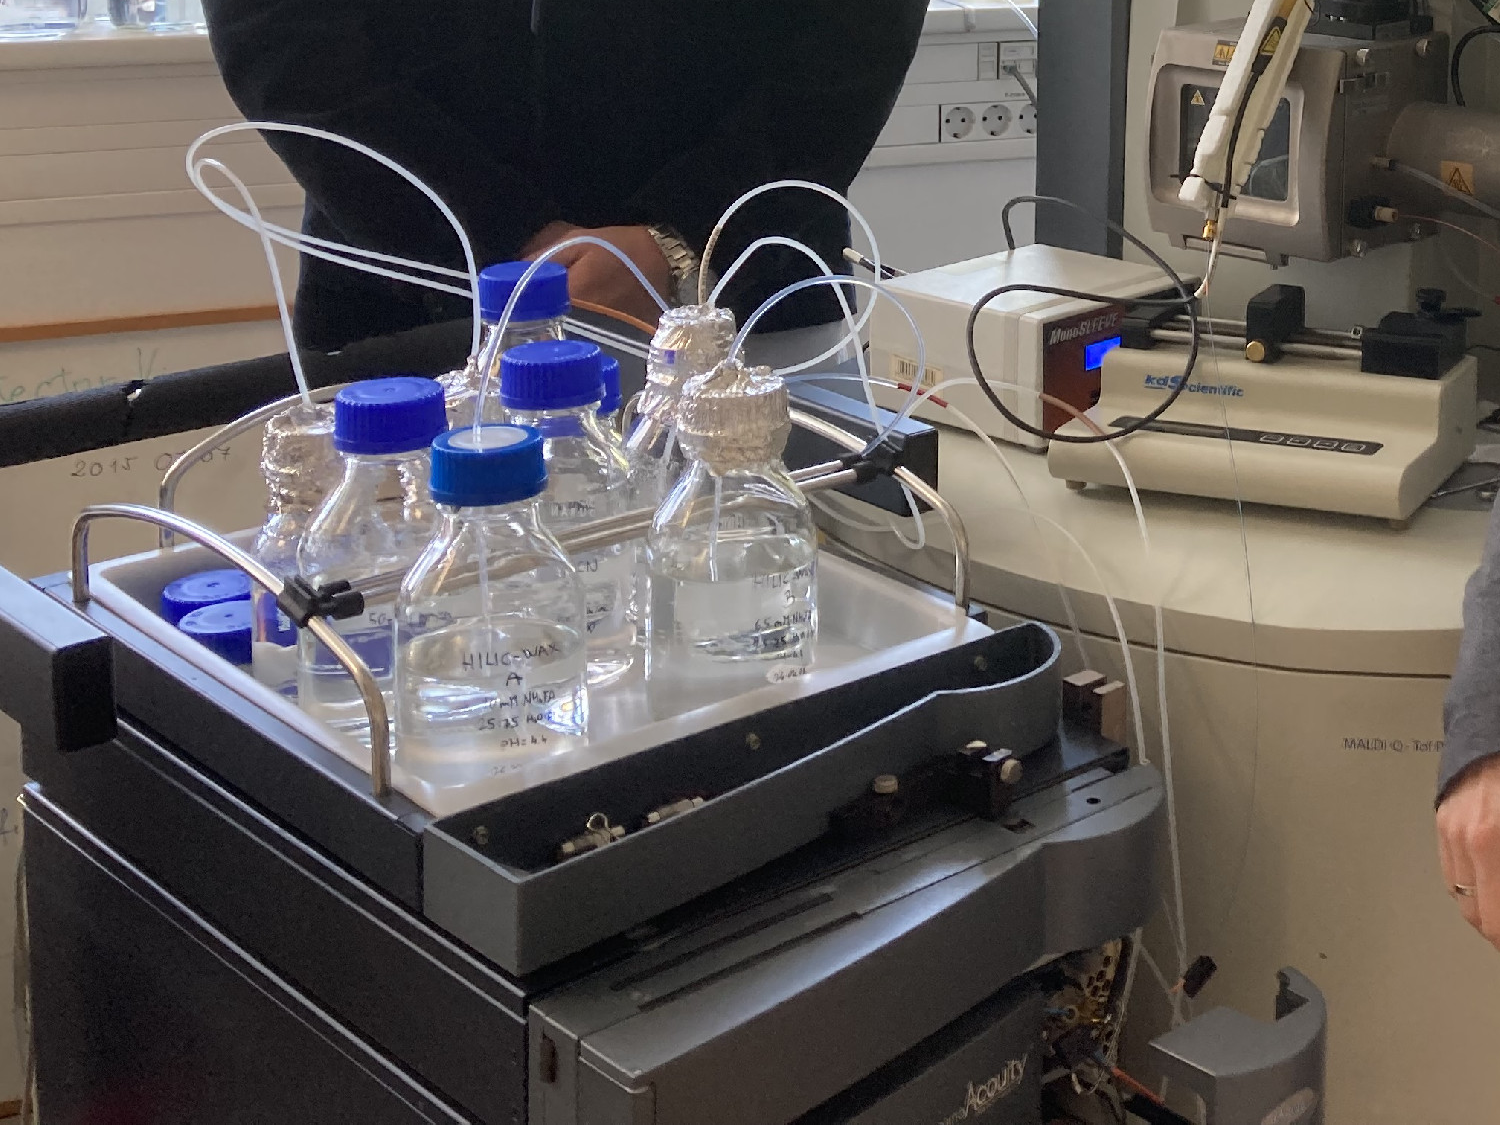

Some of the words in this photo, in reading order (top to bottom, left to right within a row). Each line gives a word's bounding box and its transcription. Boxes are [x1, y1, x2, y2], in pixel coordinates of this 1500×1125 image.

[71, 455, 139, 478] 2015
[461, 642, 562, 672] HILIC-WAX
[505, 672, 524, 687] A
[1341, 737, 1387, 752] MALDI
